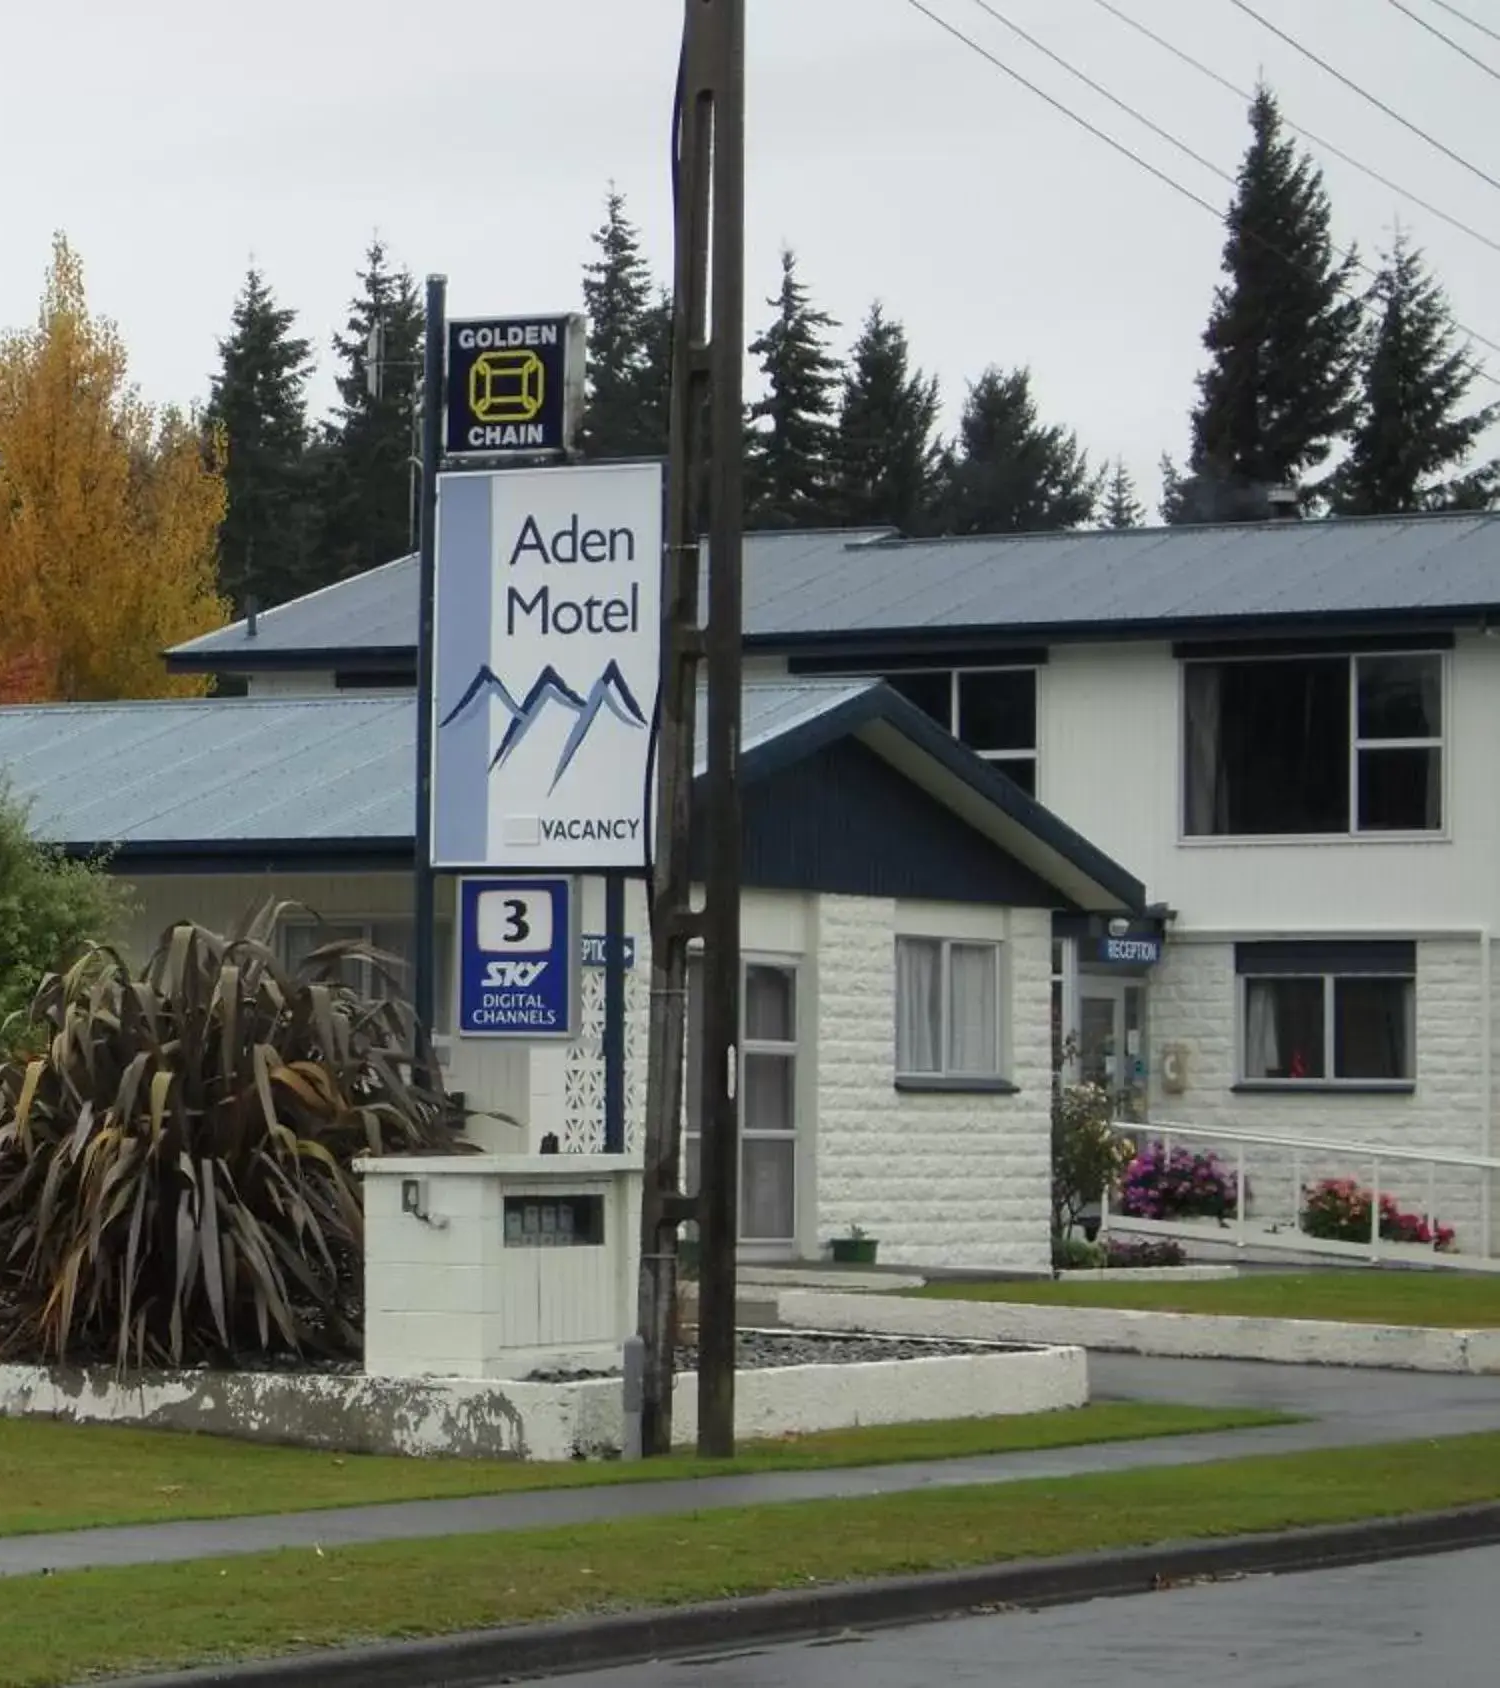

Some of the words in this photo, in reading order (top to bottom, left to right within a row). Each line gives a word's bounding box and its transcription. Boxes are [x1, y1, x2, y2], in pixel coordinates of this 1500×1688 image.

[459, 325, 557, 349] GOLDEN
[468, 423, 543, 446] CHAIN
[509, 513, 635, 565] Aden
[507, 582, 639, 636] Motel
[541, 819, 640, 840] VACANCY
[502, 899, 530, 943] 3
[481, 961, 548, 987] SKY
[483, 993, 545, 1008] DIGITAL
[472, 1009, 556, 1025] CHANNELS
